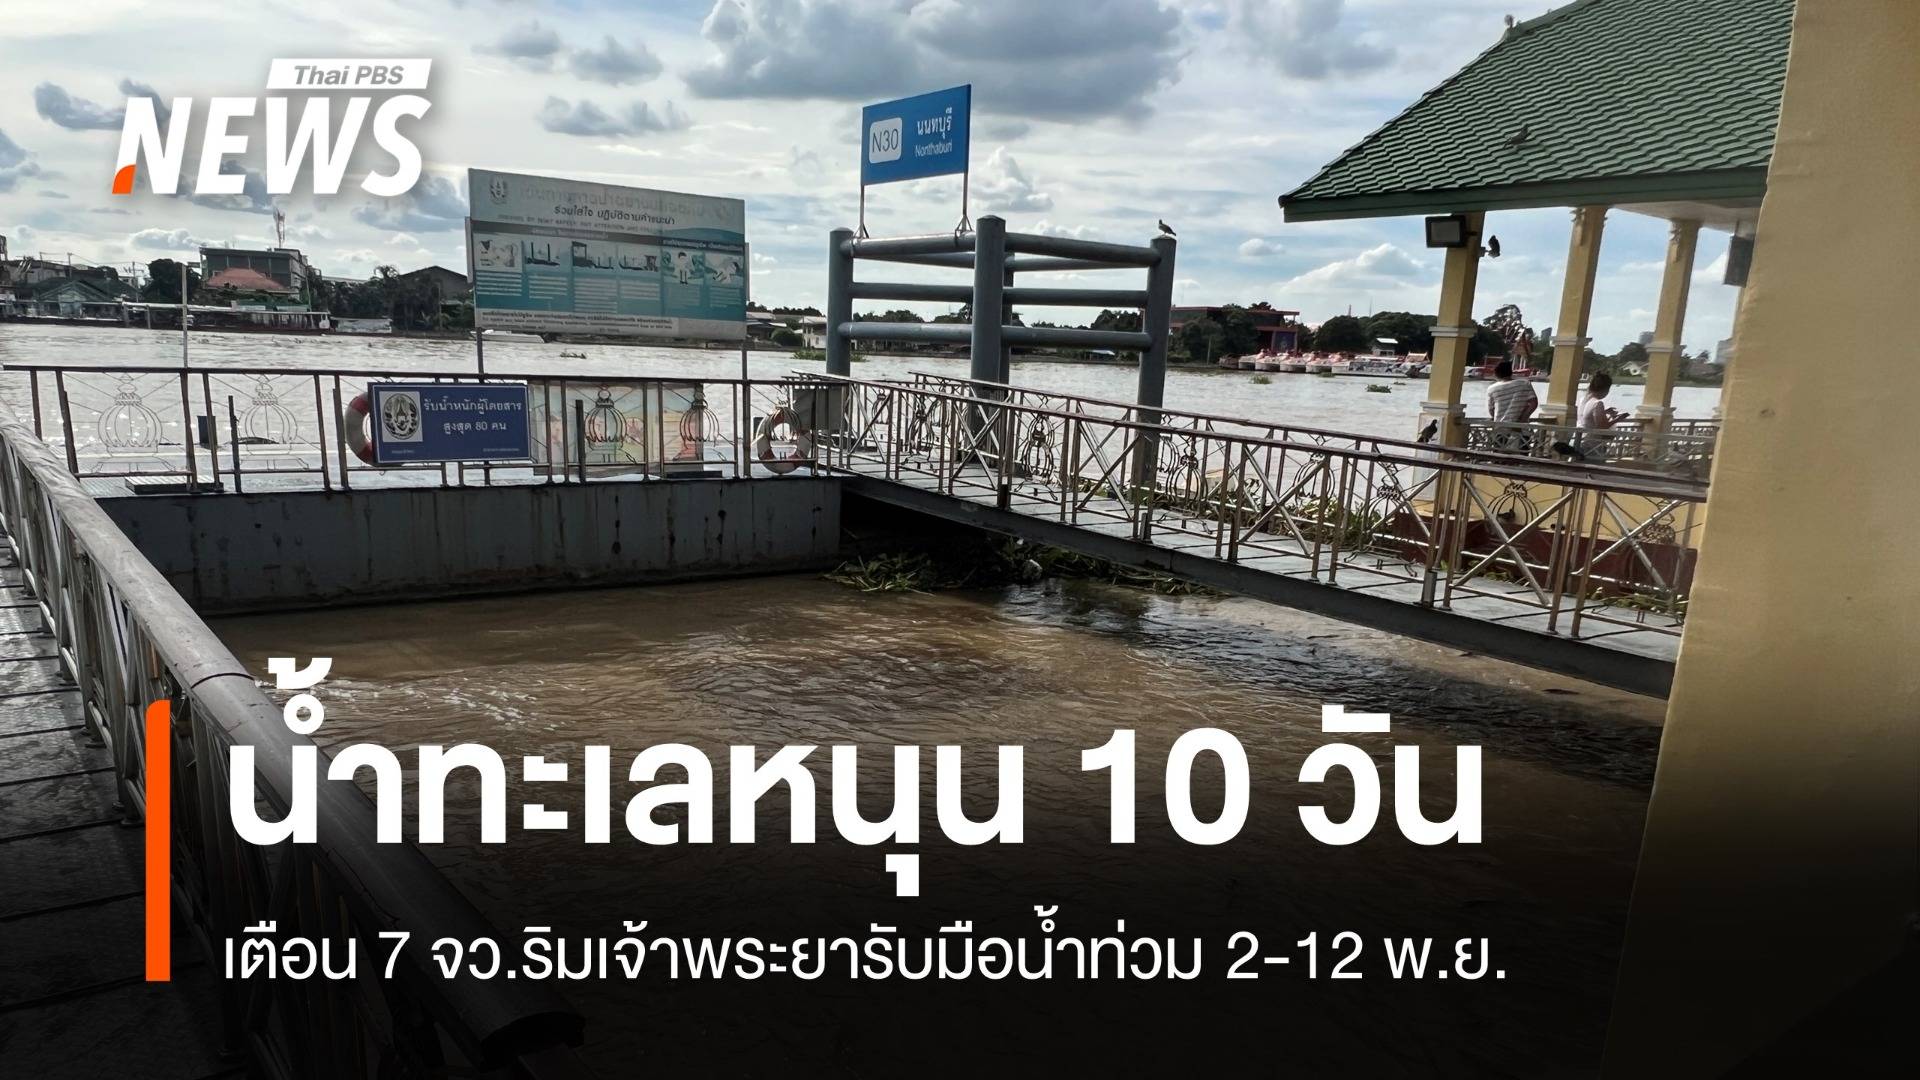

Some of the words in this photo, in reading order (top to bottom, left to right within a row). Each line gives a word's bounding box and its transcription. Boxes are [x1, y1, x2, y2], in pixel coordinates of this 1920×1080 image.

[917, 107, 952, 139] นนทบุรี
[872, 128, 899, 153] N30
[915, 139, 952, 157] Nonthaburi
[423, 395, 522, 415] รับน้ำหนักผู้โดยสาร
[443, 421, 472, 435] สูงสุด
[475, 421, 489, 431] 80
[491, 421, 508, 431] คน
